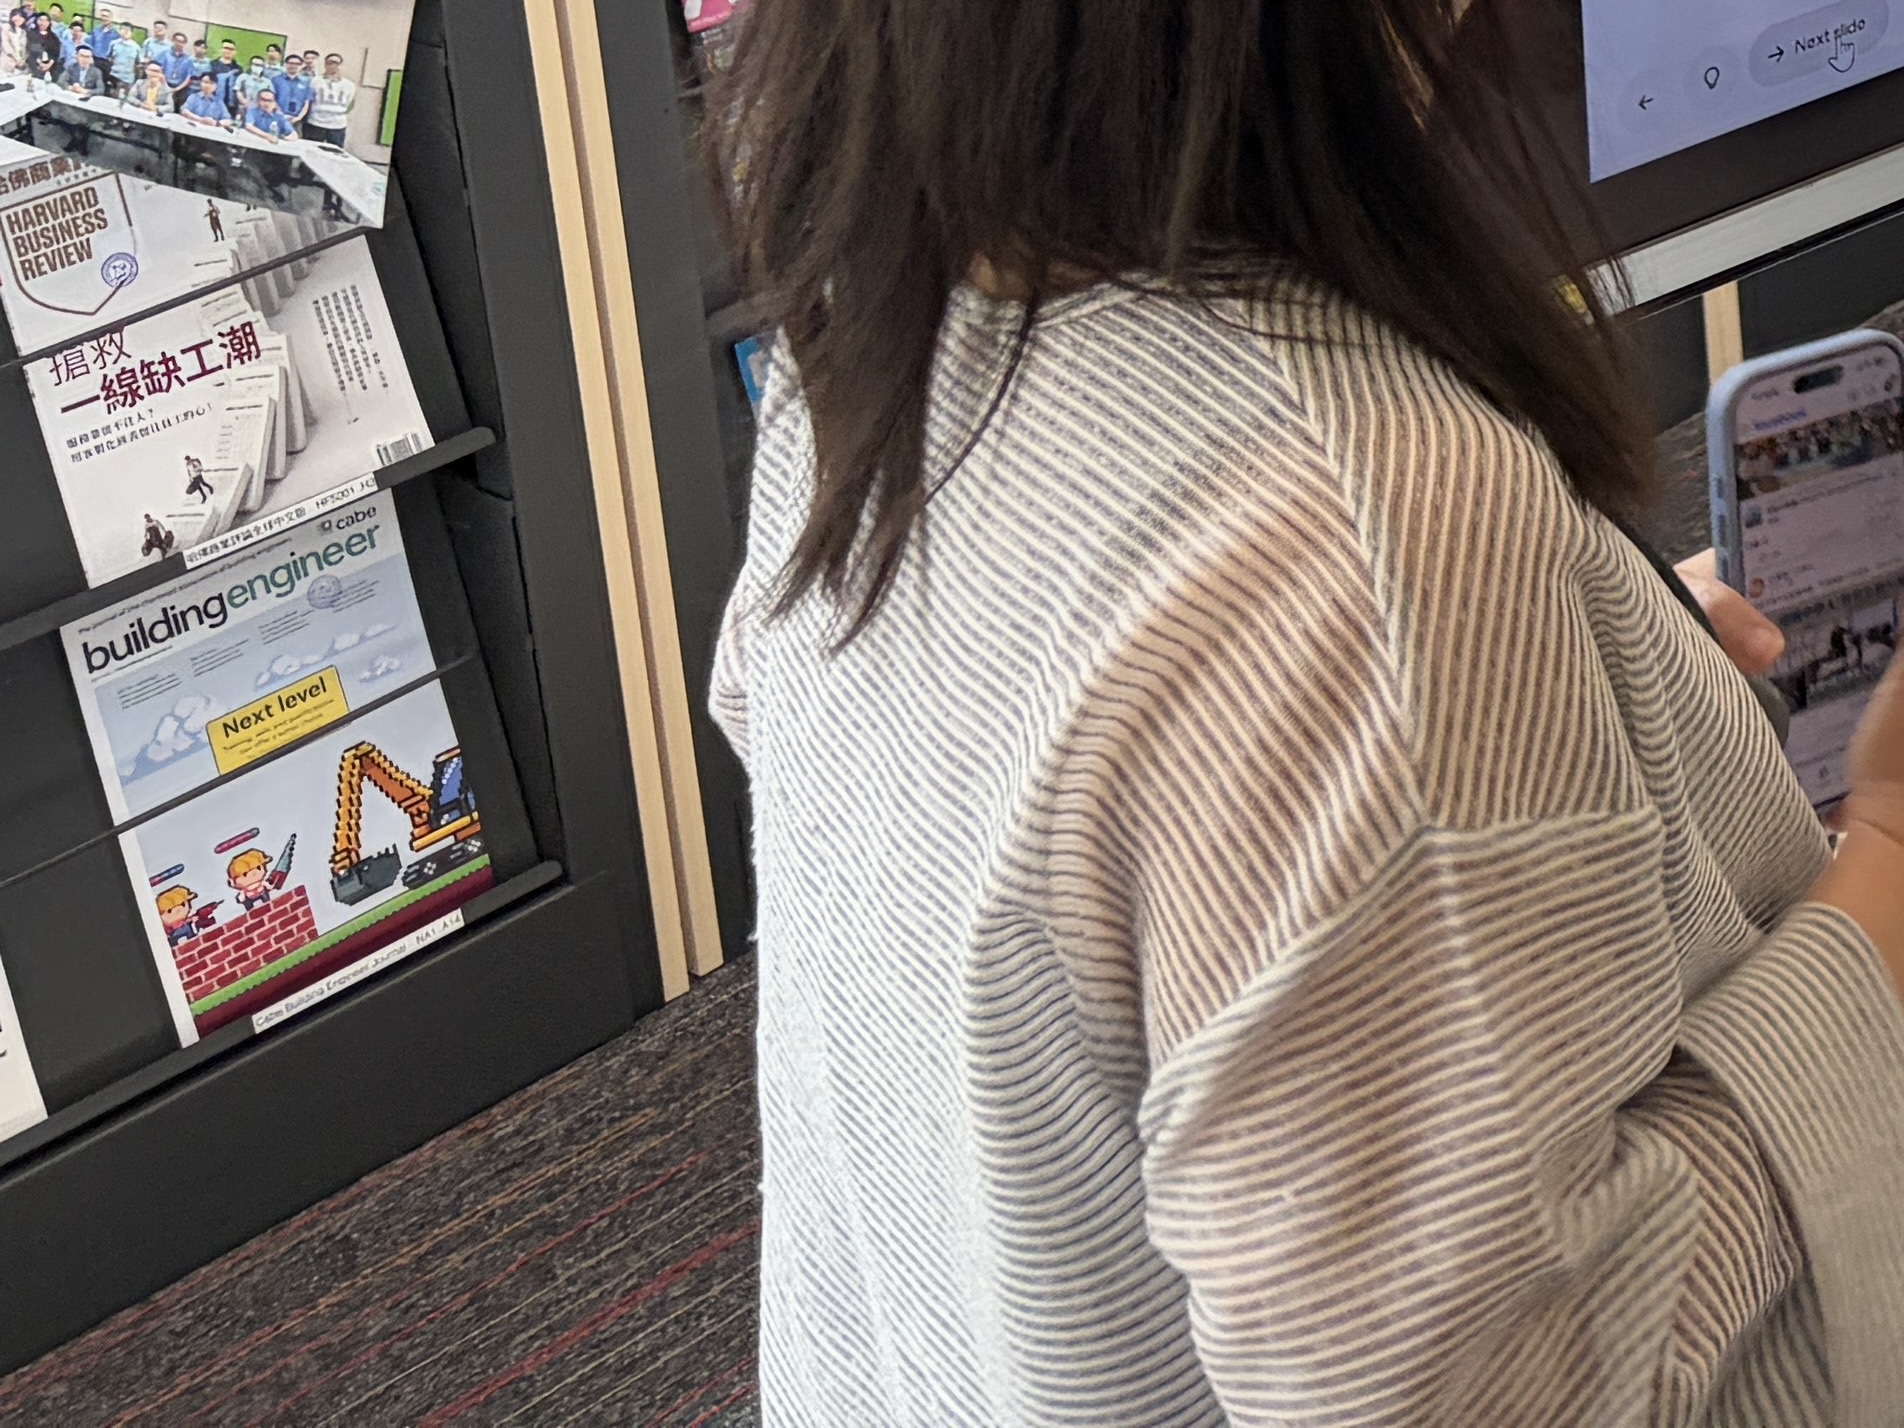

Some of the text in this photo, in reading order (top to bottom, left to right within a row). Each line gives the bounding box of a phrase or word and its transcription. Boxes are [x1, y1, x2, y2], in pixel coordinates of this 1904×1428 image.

[1794, 31, 1830, 54] Next
[0, 155, 82, 195] 哈佛商業
[6, 186, 100, 235] HARVARD
[13, 208, 109, 259] BUSINESS
[19, 237, 93, 281] REVIEW
[49, 324, 133, 387] 搶救
[60, 320, 262, 415] 一線缺工潮
[335, 504, 378, 531] cabe
[222, 704, 275, 738] Next
[278, 675, 328, 712] level
